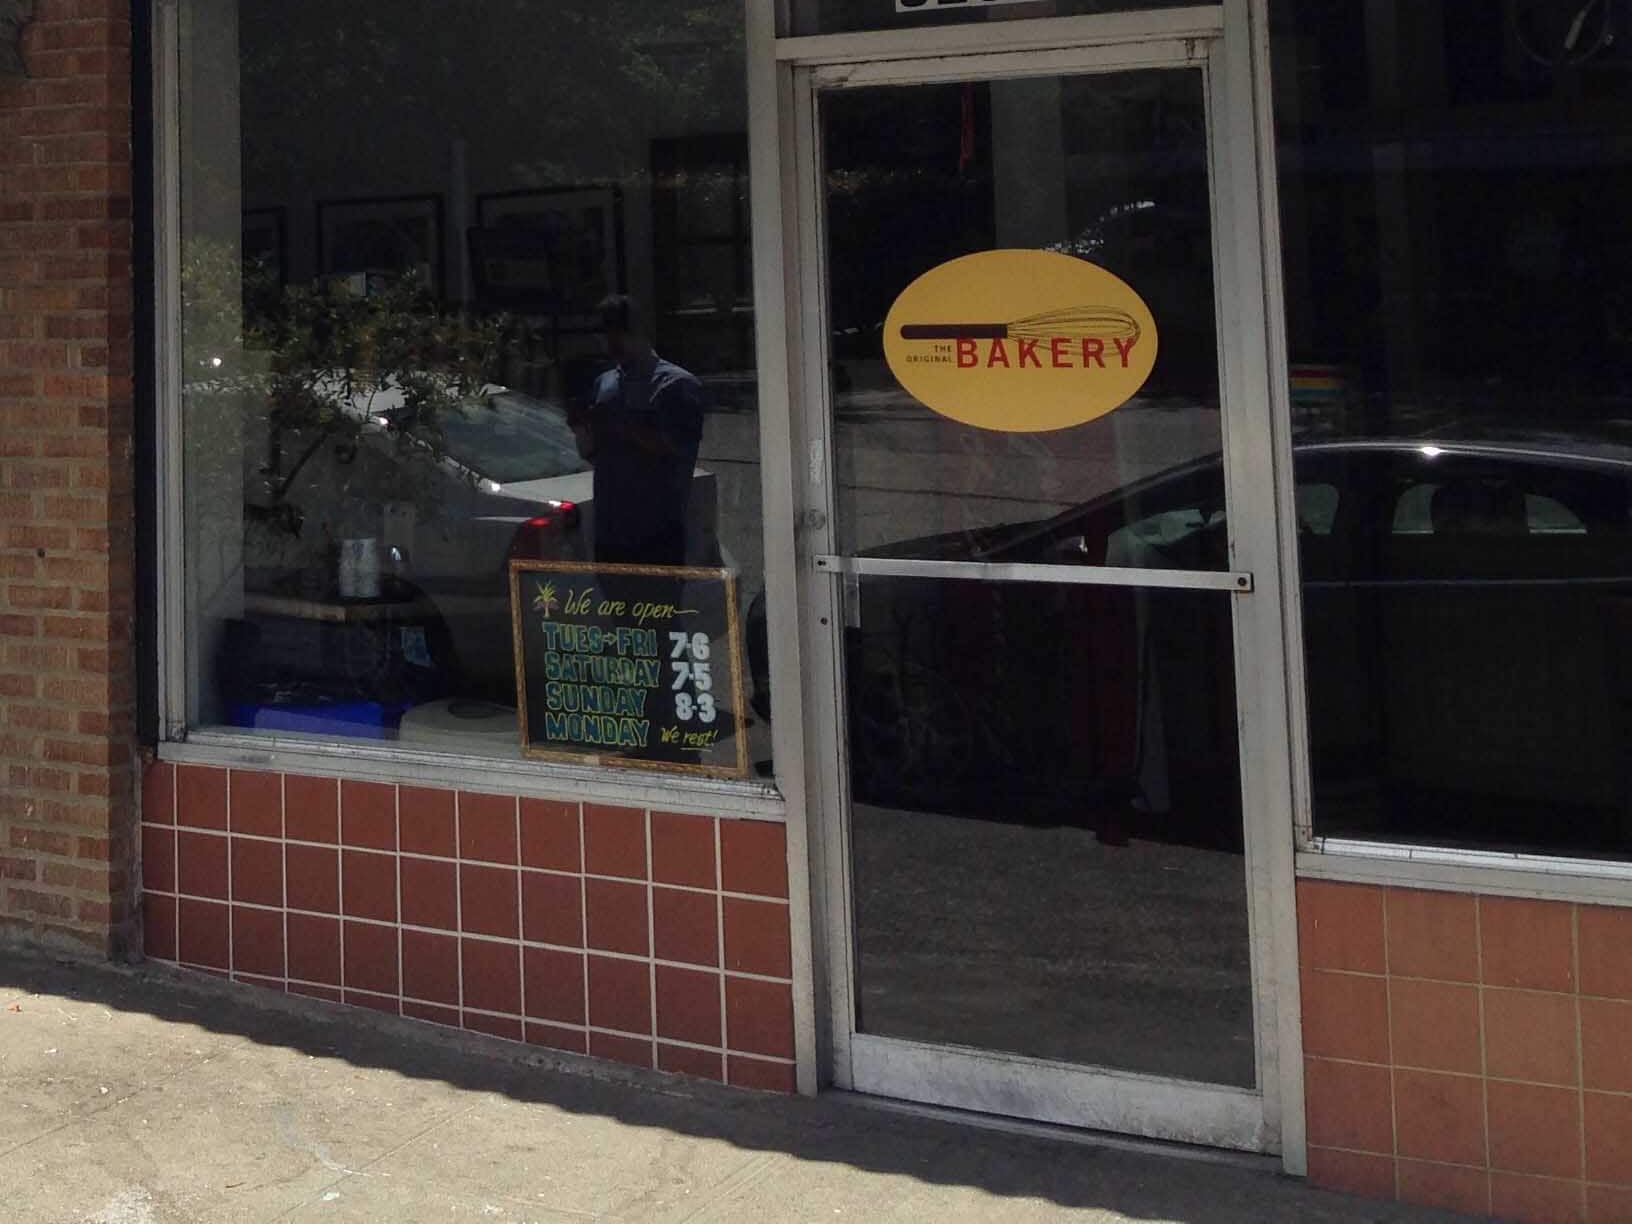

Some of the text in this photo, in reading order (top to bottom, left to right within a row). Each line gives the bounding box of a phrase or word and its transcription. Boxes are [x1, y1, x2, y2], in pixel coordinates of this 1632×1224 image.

[906, 354, 953, 364] ORIGINAL
[935, 344, 952, 353] THE
[955, 337, 1136, 369] BAKERY
[564, 588, 594, 614] We
[598, 600, 627, 615] are
[542, 621, 604, 653] TUES
[616, 627, 658, 657] FRI
[544, 651, 661, 688] SATURDAY
[545, 681, 647, 717] SUNDAY
[544, 712, 649, 747] MONDAY
[661, 725, 680, 744] We
